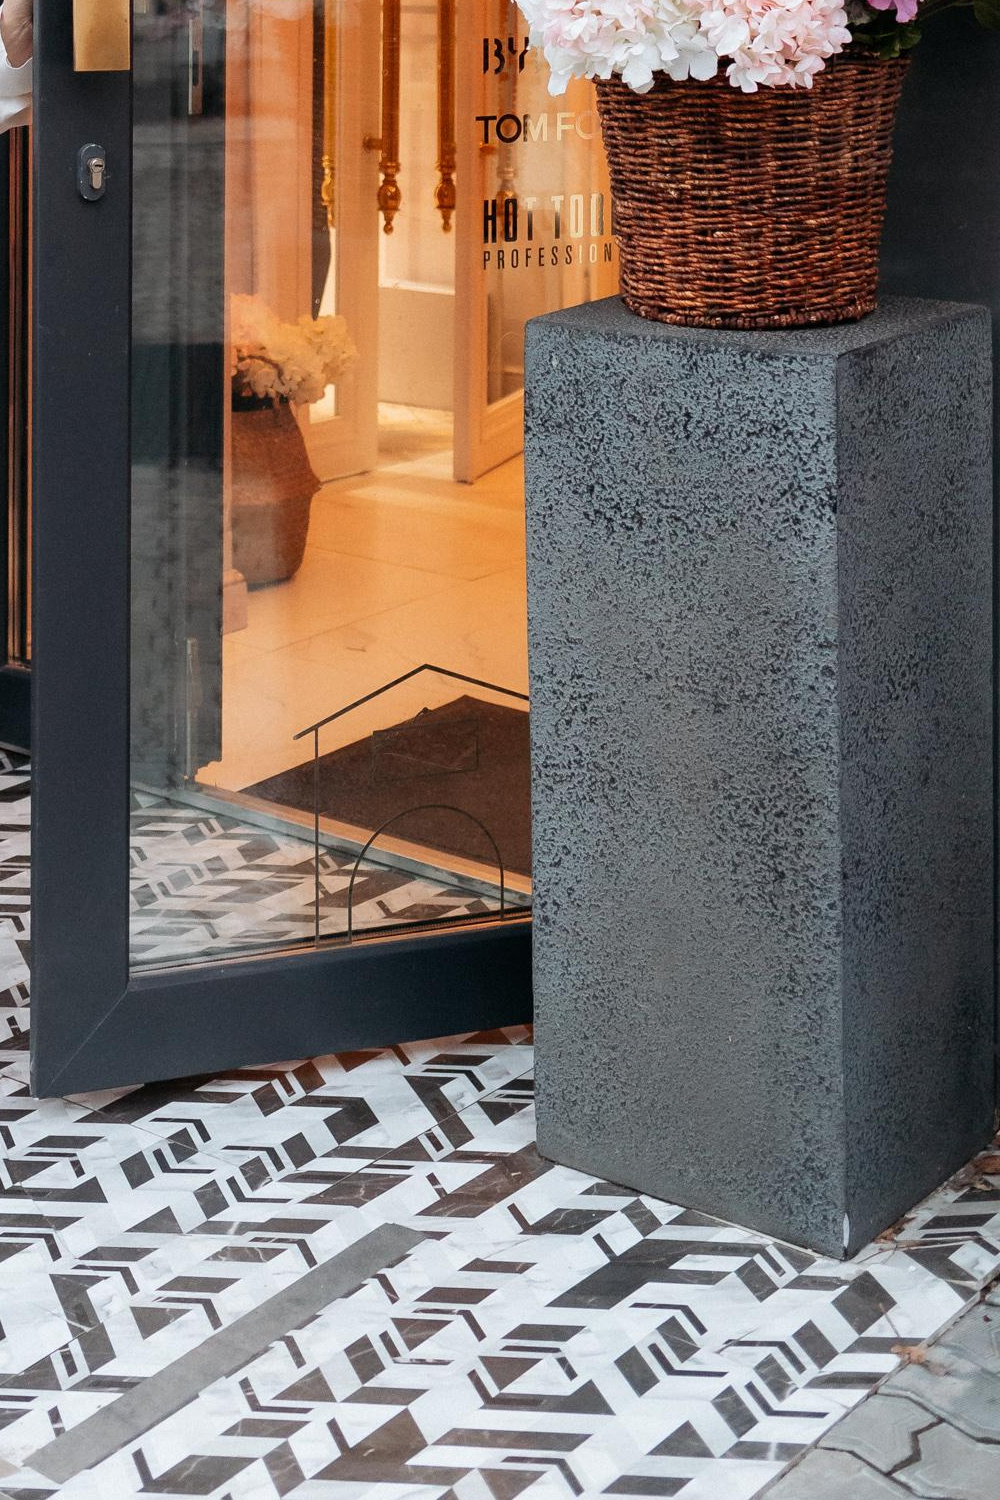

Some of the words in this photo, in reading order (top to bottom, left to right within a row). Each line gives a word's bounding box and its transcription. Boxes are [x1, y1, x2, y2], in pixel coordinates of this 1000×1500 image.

[475, 113, 548, 144] TOM
[483, 197, 536, 243] HOT
[483, 243, 613, 270] PROFESSION
